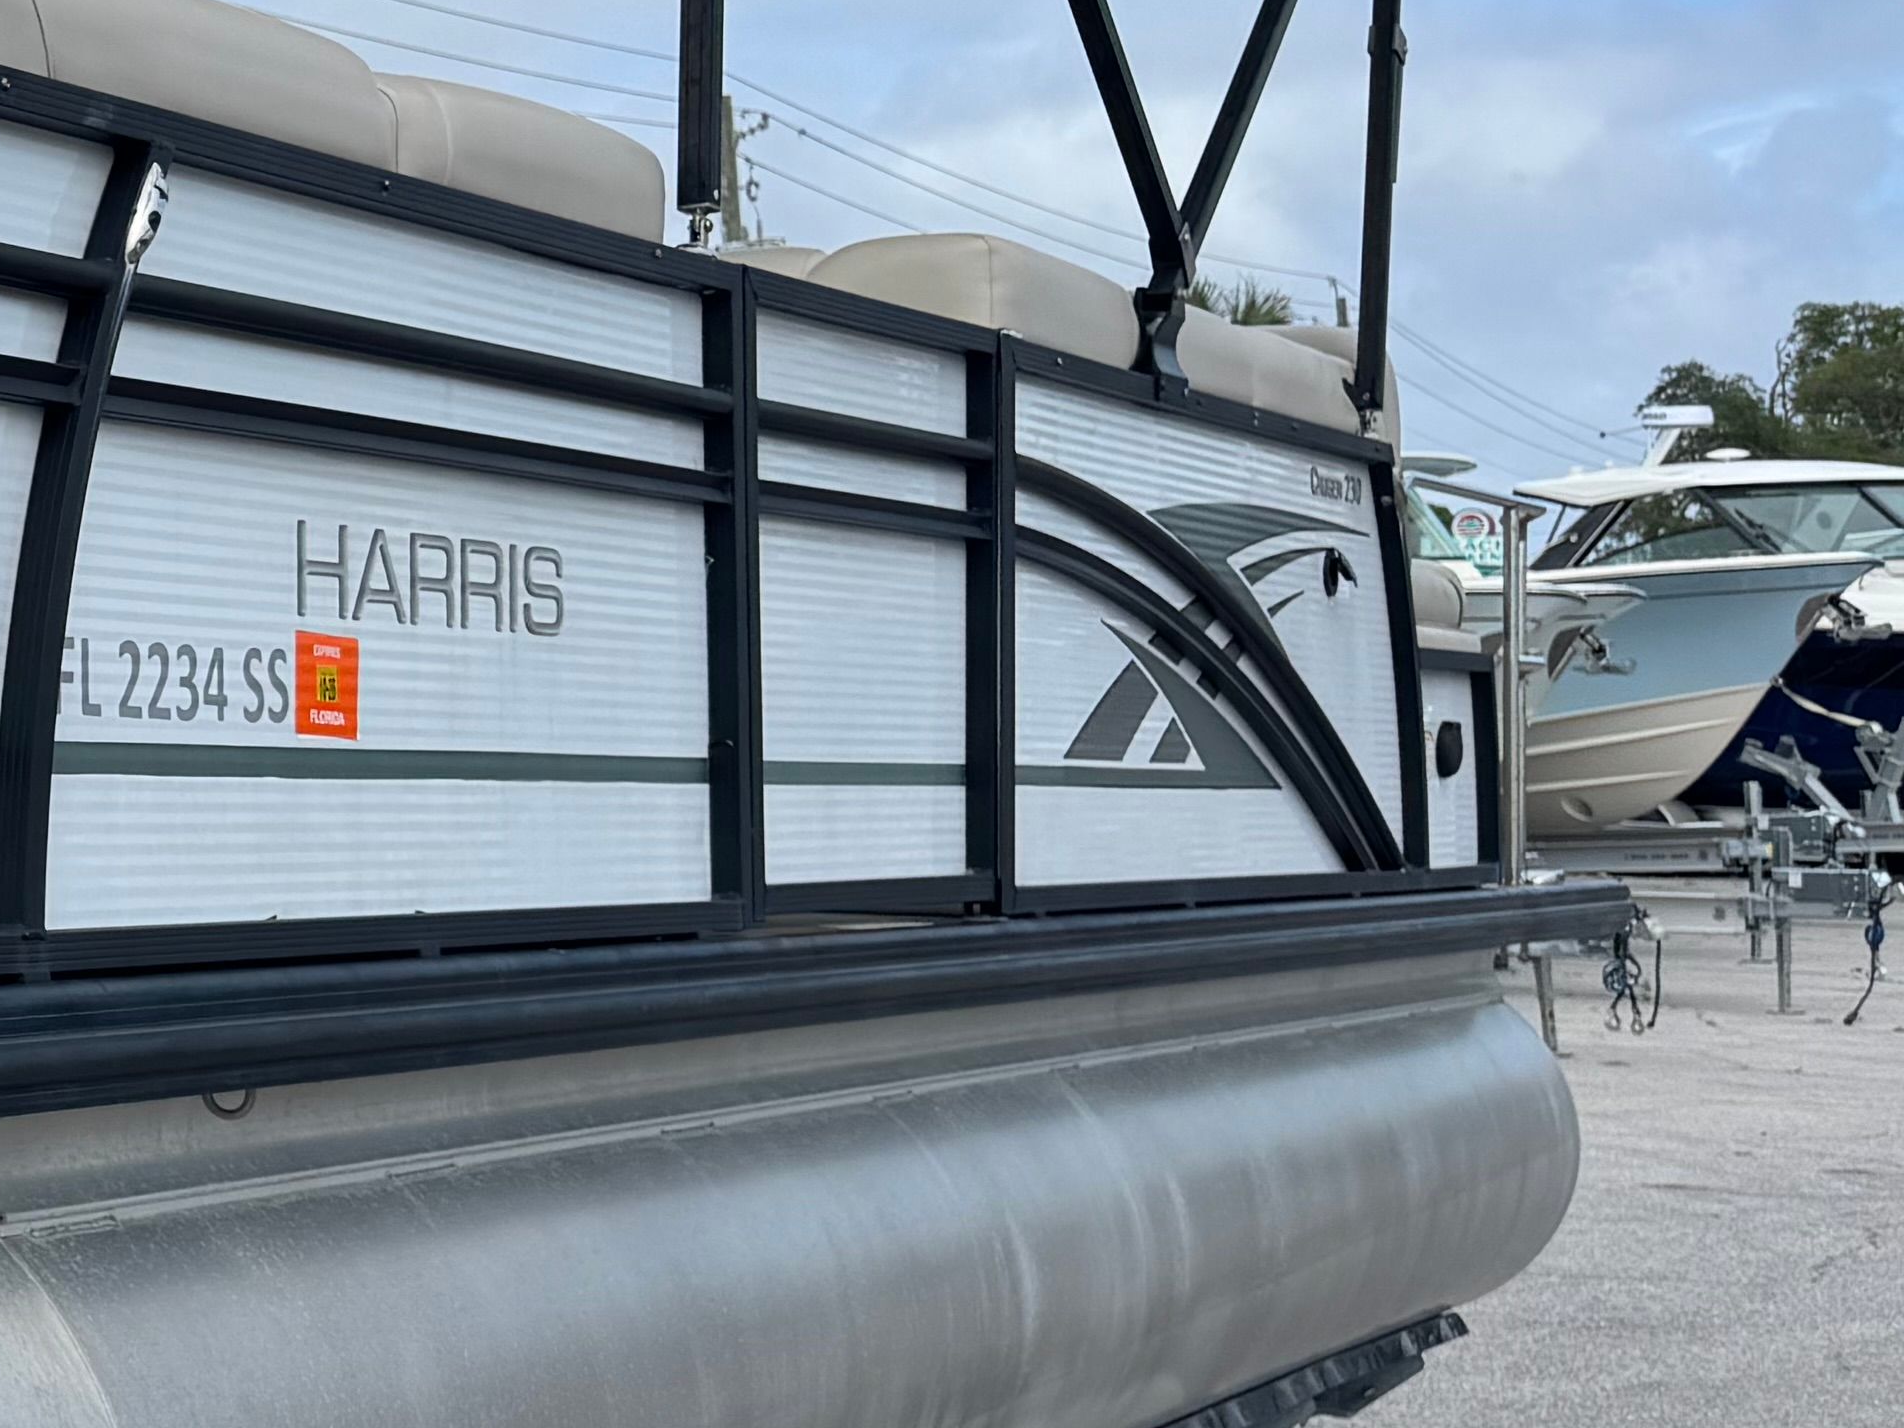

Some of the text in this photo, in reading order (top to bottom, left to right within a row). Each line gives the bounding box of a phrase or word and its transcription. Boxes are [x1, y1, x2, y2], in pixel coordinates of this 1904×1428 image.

[296, 519, 565, 637] HARRIS
[56, 636, 289, 724] FL 2234 SS
[309, 708, 345, 726] FLORIDA
